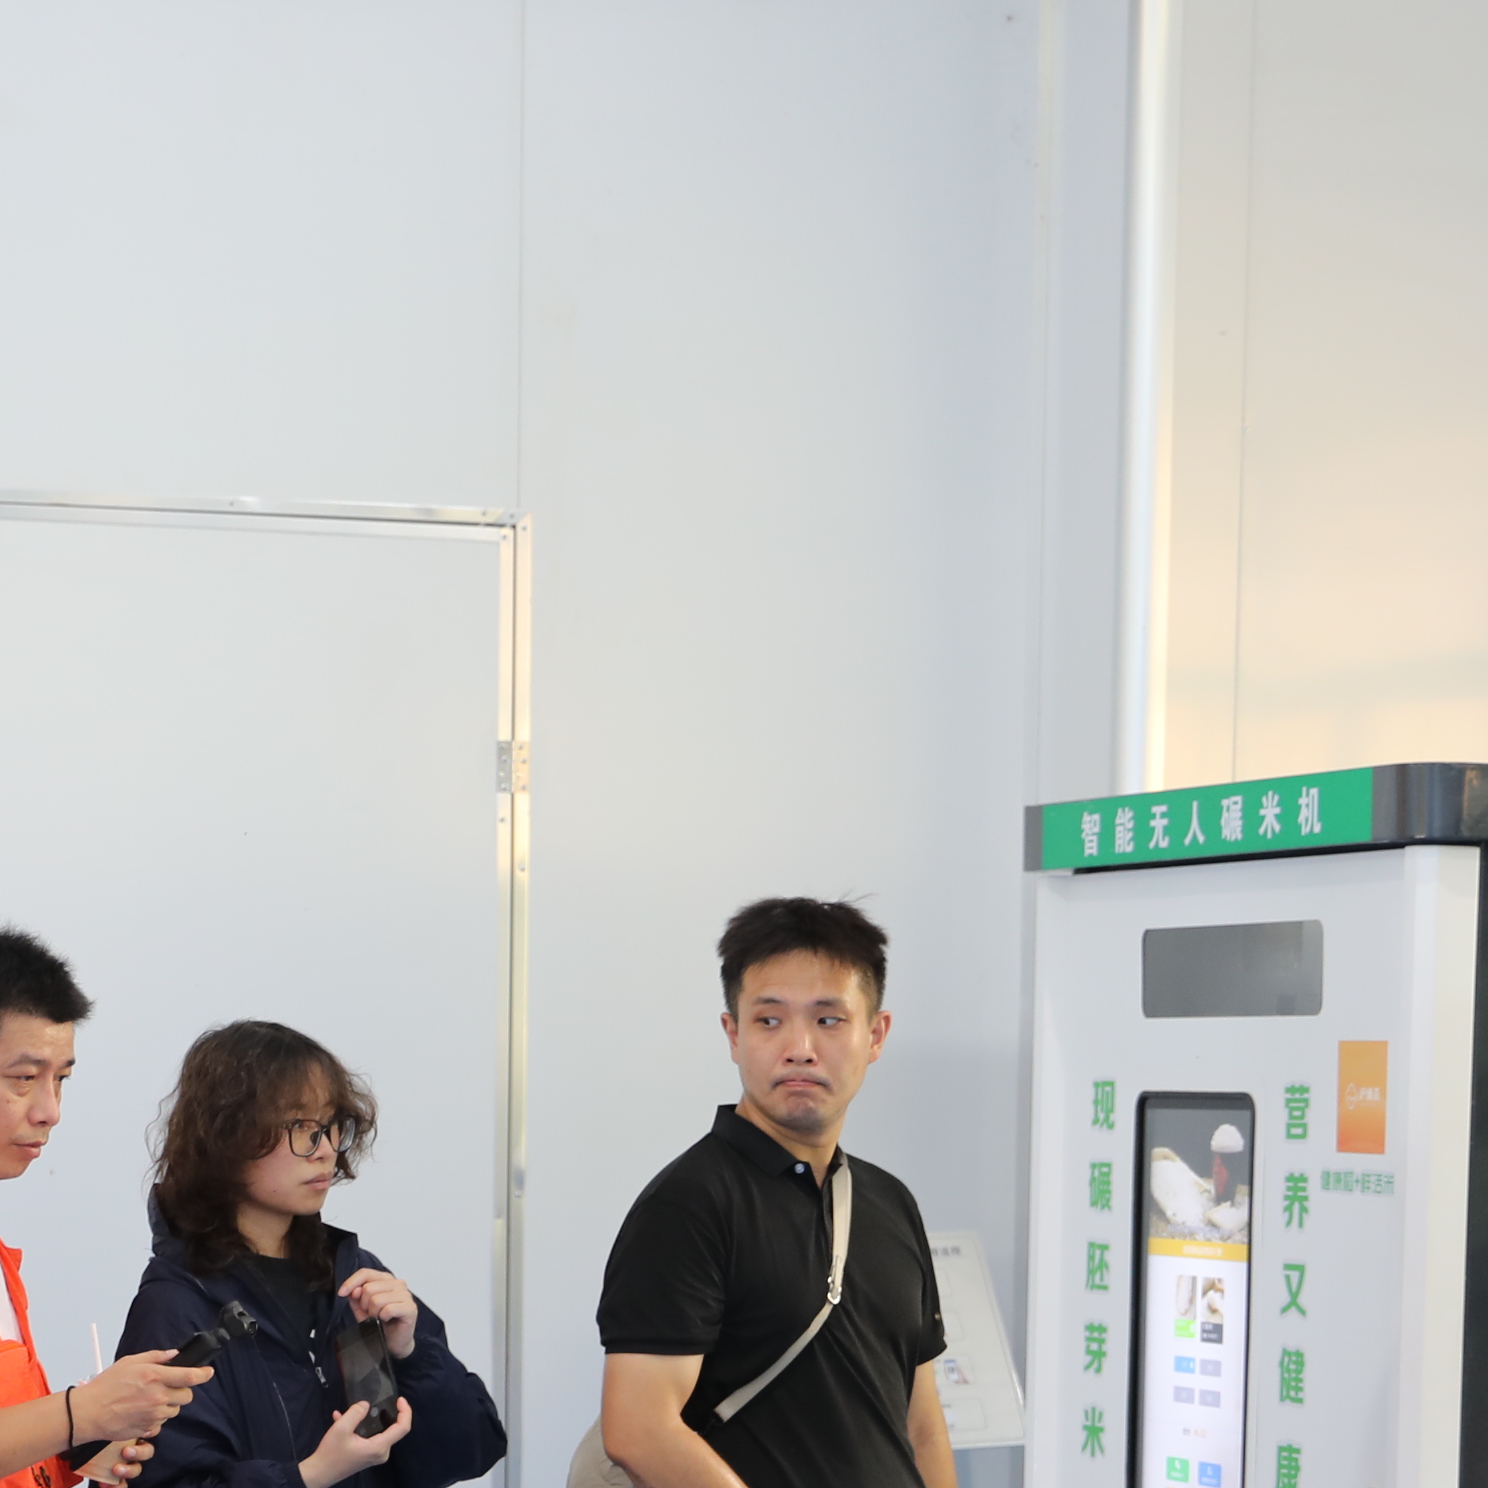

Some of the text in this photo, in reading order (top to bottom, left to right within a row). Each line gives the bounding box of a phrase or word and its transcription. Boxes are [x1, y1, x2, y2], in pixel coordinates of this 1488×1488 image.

[1080, 786, 1322, 857] 智能无人碾米机
[1080, 1080, 1116, 1458] 现碾胚芽米
